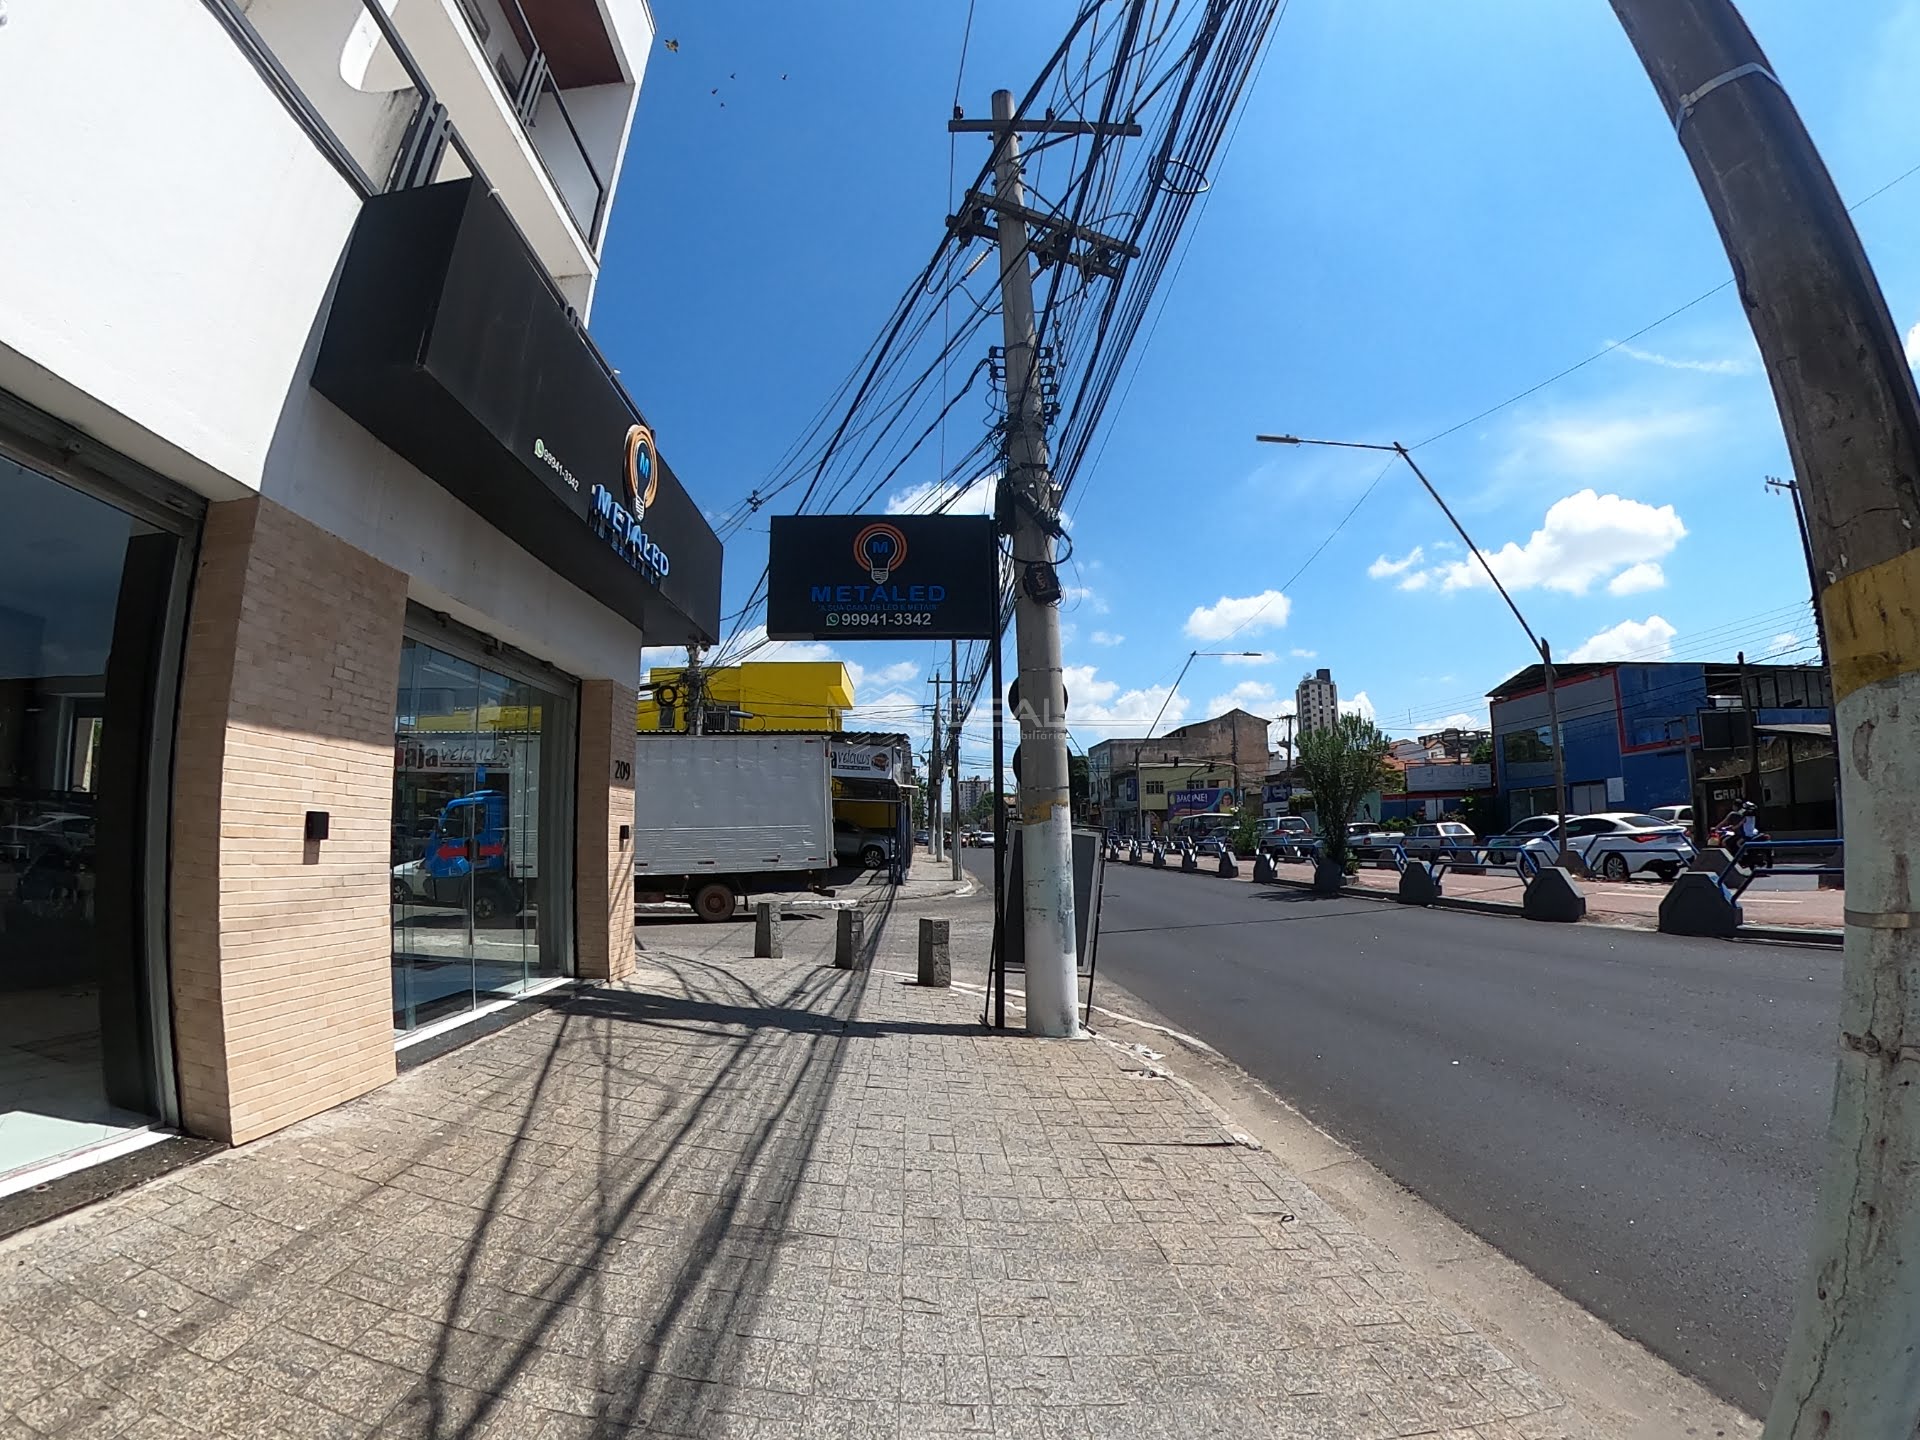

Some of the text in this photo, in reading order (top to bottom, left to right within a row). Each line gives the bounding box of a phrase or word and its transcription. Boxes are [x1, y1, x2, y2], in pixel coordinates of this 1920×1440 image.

[594, 484, 670, 577] METALED
[811, 585, 945, 602] METALED
[841, 613, 932, 626] 99941-3342
[615, 760, 630, 781] 209
